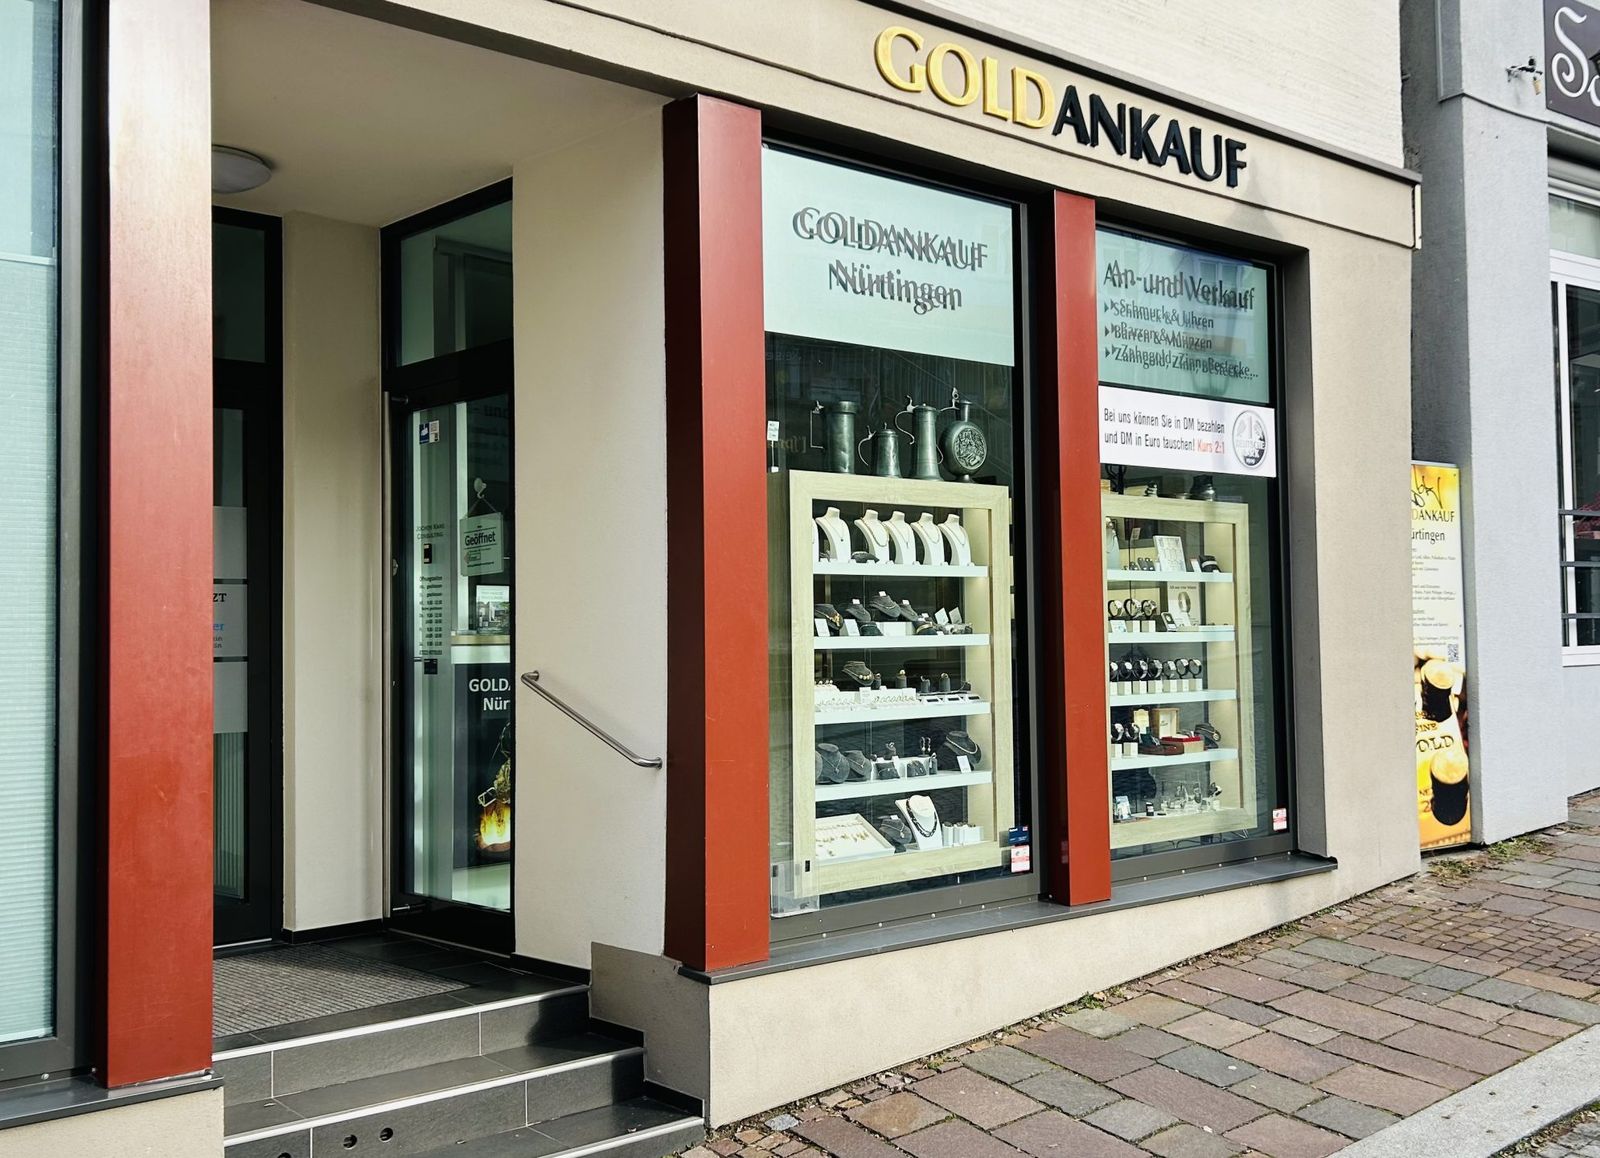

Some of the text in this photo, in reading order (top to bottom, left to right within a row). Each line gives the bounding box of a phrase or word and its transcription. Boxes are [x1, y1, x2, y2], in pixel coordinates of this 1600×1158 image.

[874, 26, 1247, 188] GOLDANKAUF
[792, 206, 988, 271] GOLDANKAUF
[828, 259, 962, 315] Nürtingen
[1186, 276, 1255, 310] Verkauf
[1104, 408, 1225, 434] Bei uns können Sie in DM bezahlen
[1104, 431, 1118, 444] und
[1120, 432, 1133, 446] DM
[1135, 432, 1142, 447] in
[1145, 434, 1160, 448] Euro
[1163, 436, 1195, 452] tauschen!
[1197, 438, 1213, 453] Kurs
[1214, 440, 1225, 454] 2:1
[464, 532, 496, 547] Geöffnet
